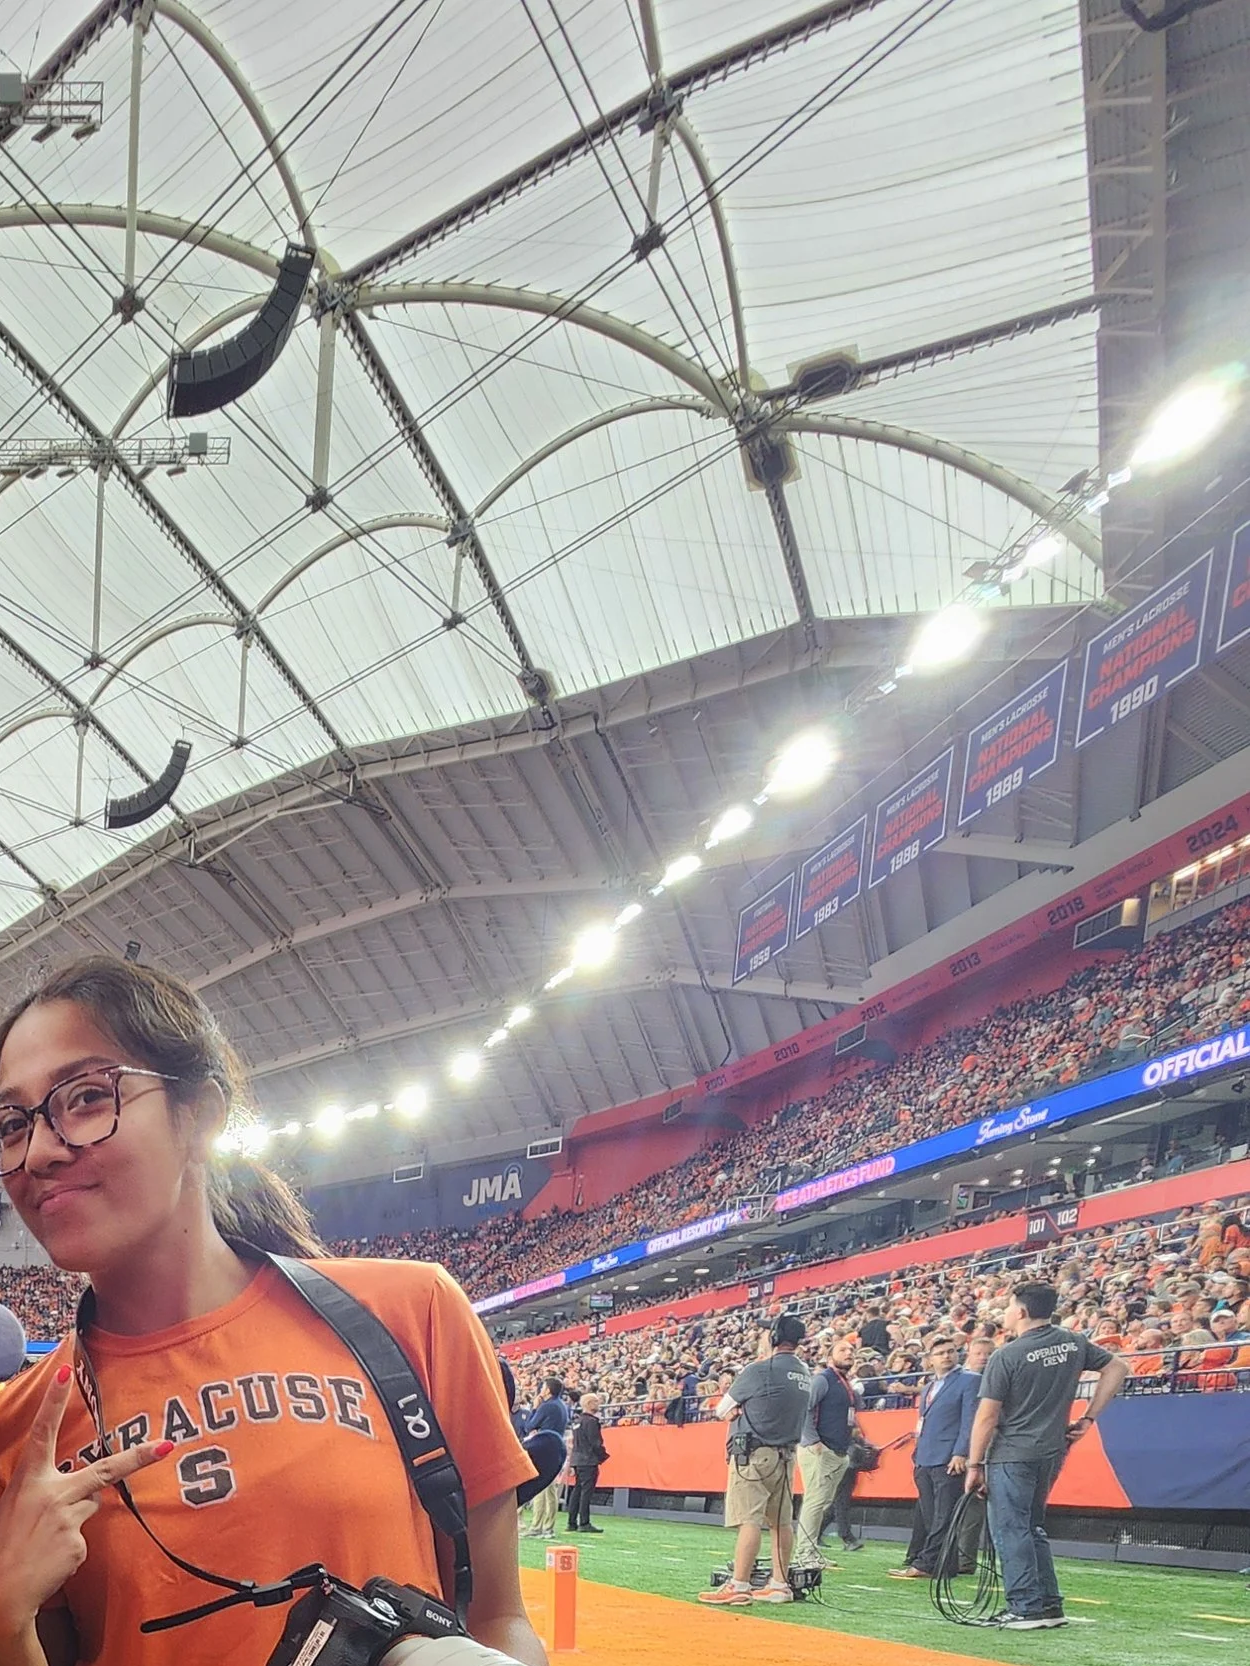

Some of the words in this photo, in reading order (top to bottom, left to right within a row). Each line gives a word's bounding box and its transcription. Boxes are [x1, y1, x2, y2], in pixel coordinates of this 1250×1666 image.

[1103, 622, 1133, 654] MEN'S
[1135, 581, 1191, 632] LACROSSE
[1098, 604, 1190, 677] NATIONAL
[1087, 617, 1196, 711] CHAMPIONS
[981, 718, 1005, 745] MEN'S
[1006, 686, 1049, 727] LACROSSE
[1110, 674, 1158, 725] 1990
[967, 718, 1054, 793] CHAMPIONS
[978, 706, 1050, 765] NATIONAL
[985, 766, 1024, 807] 1989
[876, 798, 943, 860] CHAMPIONS
[884, 787, 939, 837] NATIONAL
[1186, 813, 1239, 853] 2024
[890, 839, 920, 874] 1988
[814, 896, 839, 927] 1983
[1047, 896, 1085, 926] 2018
[749, 945, 770, 972] 1959
[950, 952, 981, 977] 2013
[860, 1001, 887, 1022] 2012
[773, 1042, 800, 1063] 2010
[1142, 1031, 1250, 1086] OFFICIAL
[1014, 1105, 1049, 1132] Stone
[462, 1173, 522, 1207] JMA
[799, 1172, 857, 1203] ATHLETICS
[860, 1156, 895, 1183] FUND
[1028, 1216, 1046, 1235] 101
[1057, 1208, 1078, 1227] 102
[647, 1231, 681, 1254] OFFICIAL
[176, 1444, 236, 1509] S
[426, 1609, 452, 1628] SONY
